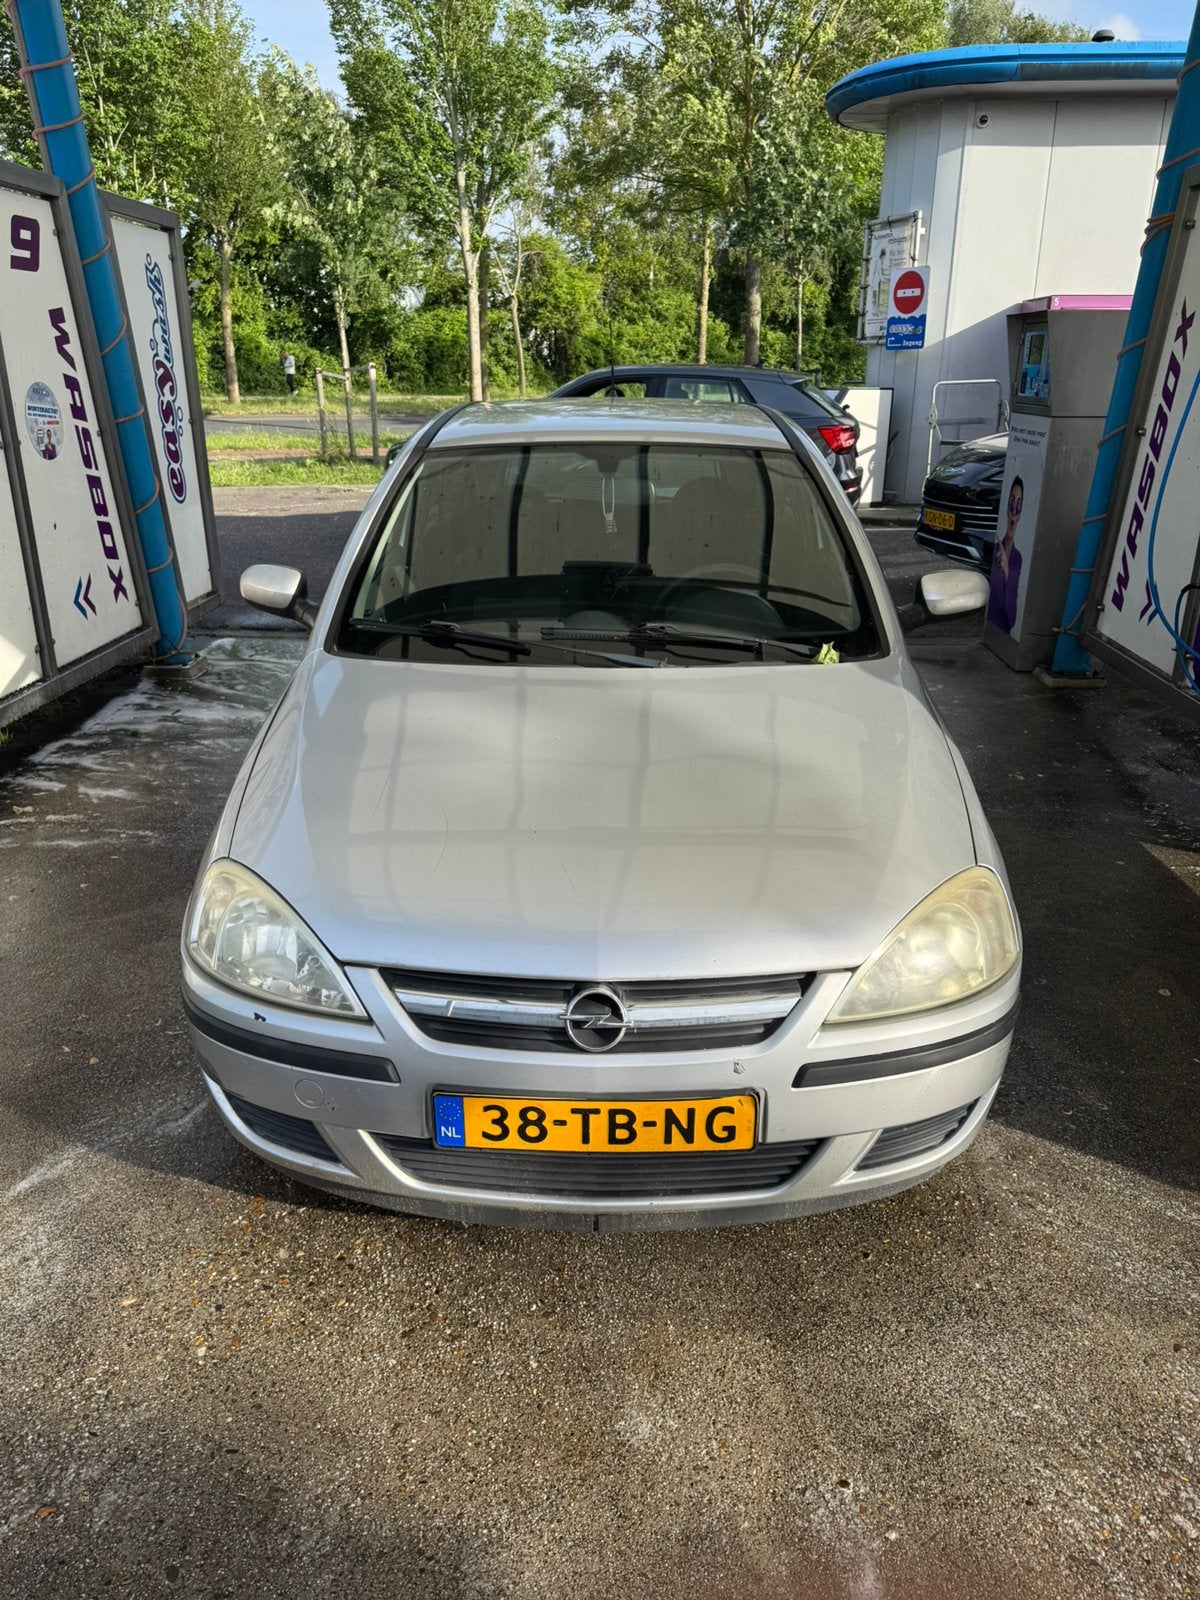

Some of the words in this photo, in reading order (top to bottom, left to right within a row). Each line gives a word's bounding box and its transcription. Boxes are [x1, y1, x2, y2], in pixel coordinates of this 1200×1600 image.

[1054, 297, 1060, 306] 5
[902, 339, 923, 347] Ingang
[48, 306, 130, 604] WASBOX
[1110, 296, 1196, 613] WASBOX
[441, 1126, 461, 1138] NL
[481, 1105, 737, 1145] 38-TB-NG
